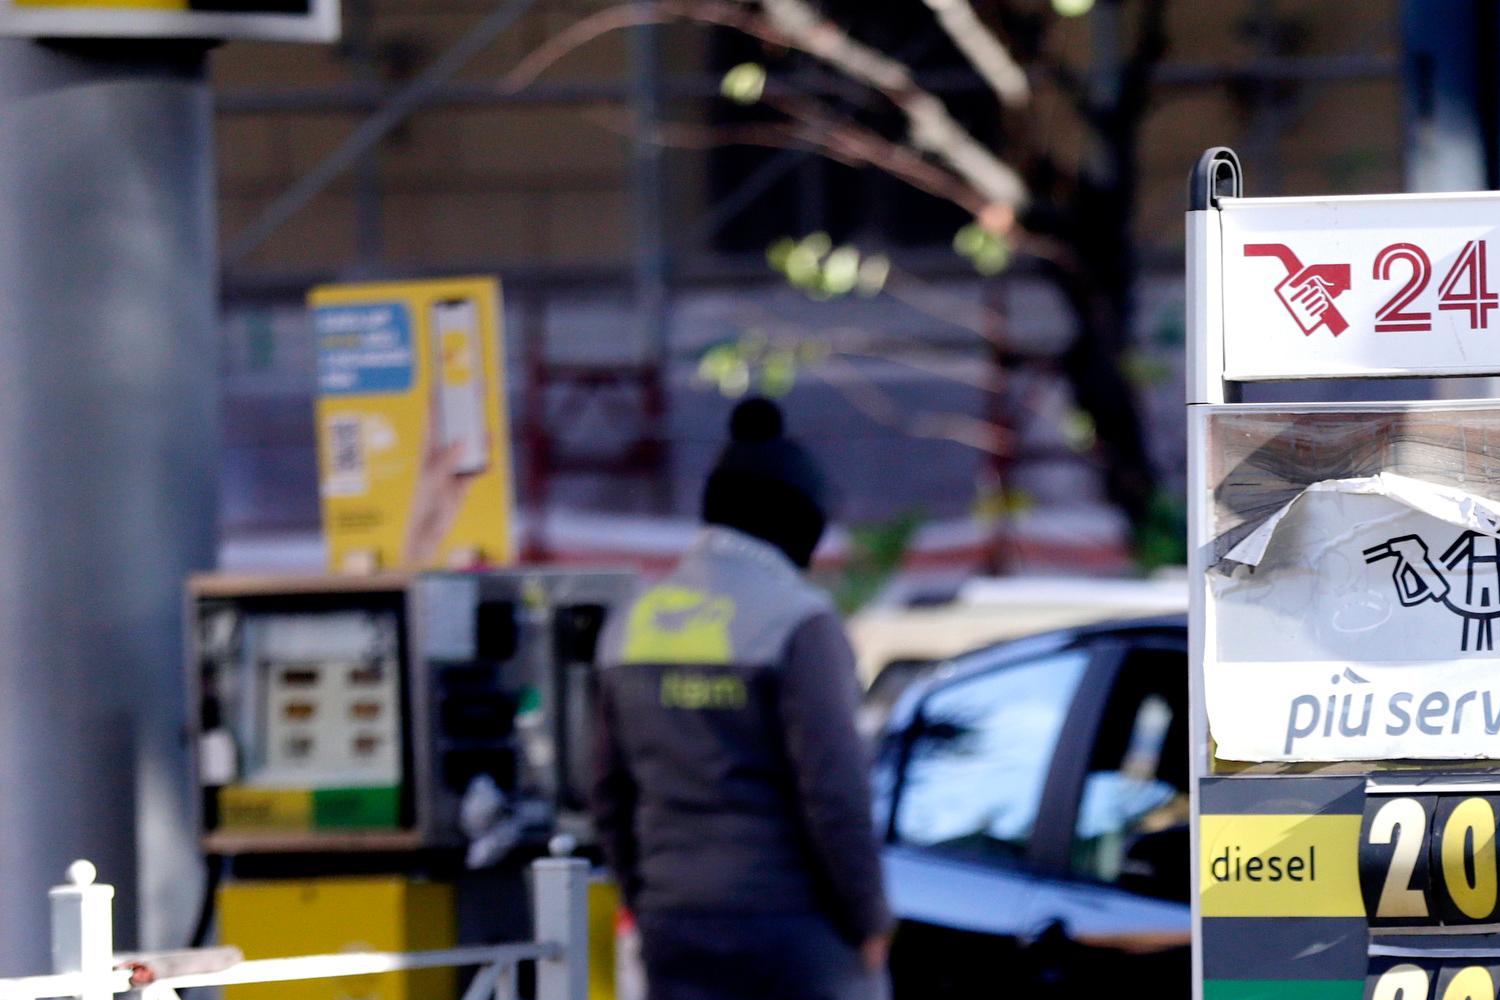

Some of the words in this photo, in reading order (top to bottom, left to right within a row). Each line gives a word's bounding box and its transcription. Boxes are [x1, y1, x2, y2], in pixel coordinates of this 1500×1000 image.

[1372, 240, 1499, 333] 24
[1284, 668, 1374, 756] più
[1210, 845, 1316, 882] diesel
